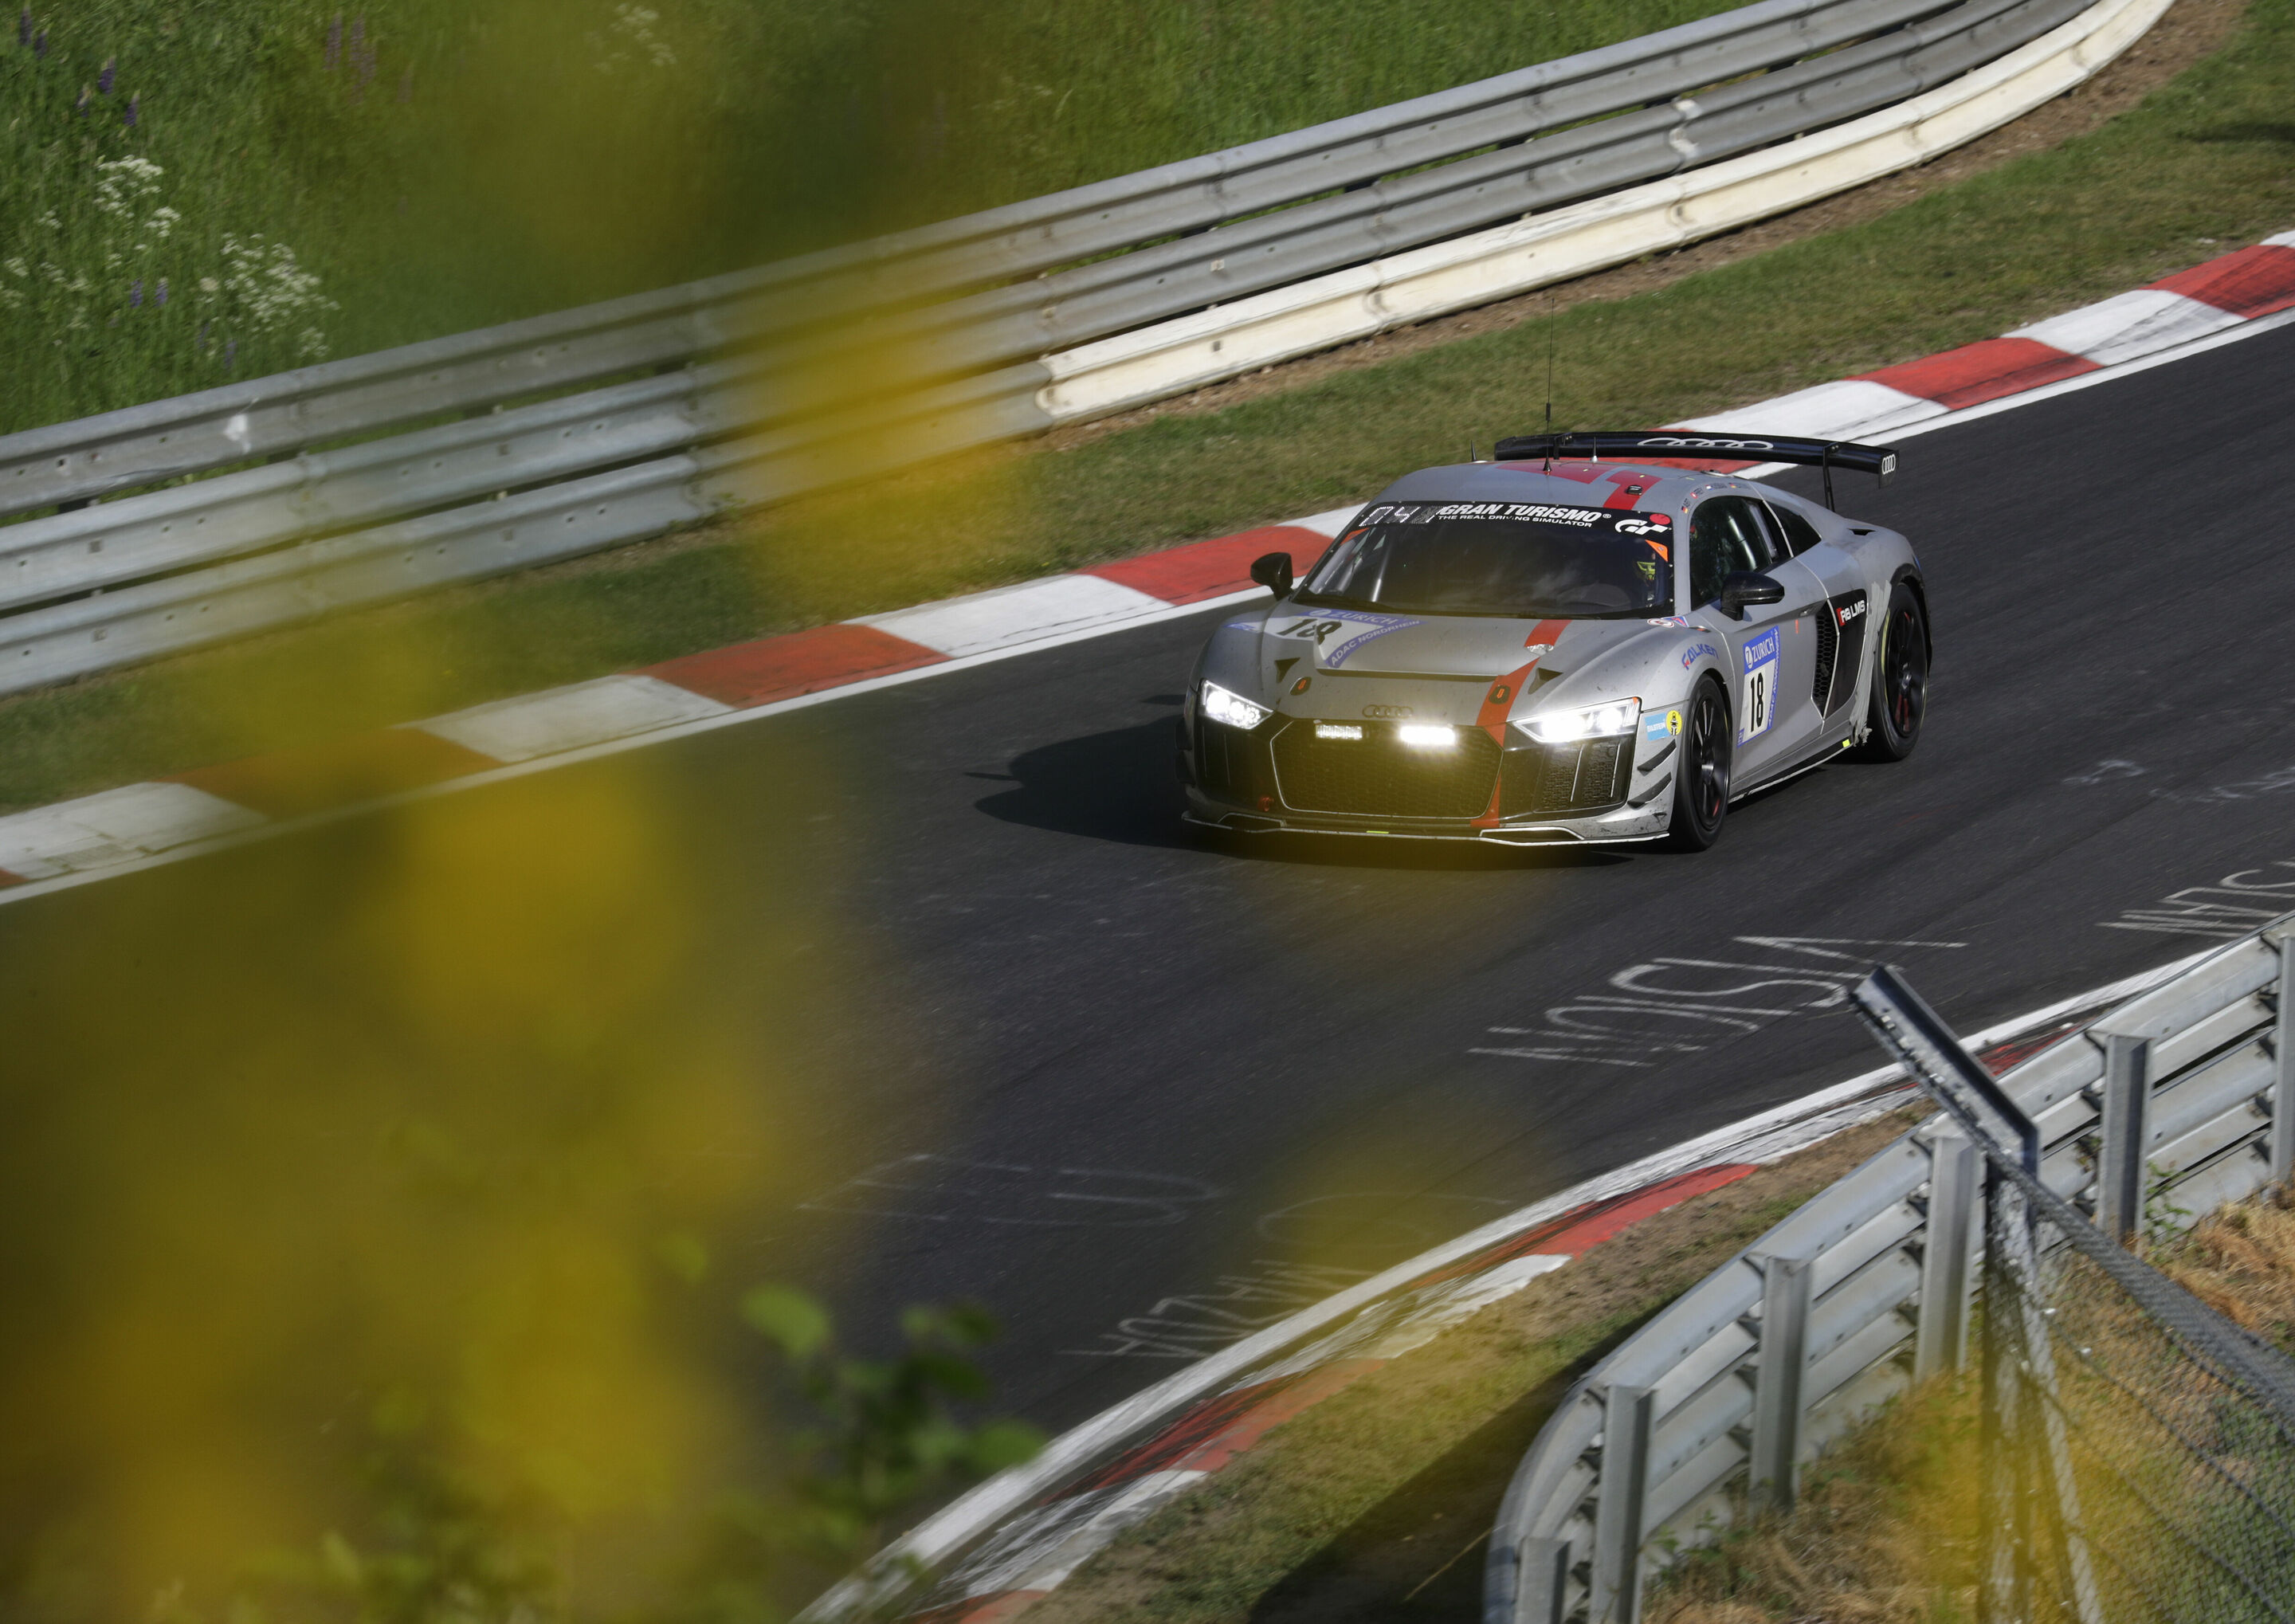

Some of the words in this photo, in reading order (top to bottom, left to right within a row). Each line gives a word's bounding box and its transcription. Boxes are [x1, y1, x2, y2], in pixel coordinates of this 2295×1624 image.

[1440, 504, 1504, 515] GRAN
[1532, 516, 1592, 528] SIMULATOR
[1329, 610, 1399, 625] ZURICH
[1850, 600, 1865, 618] LMS
[1331, 640, 1356, 666] ADAC
[1359, 620, 1420, 643] NORDRHEIN
[1752, 637, 1775, 662] ZURICH
[1681, 643, 1719, 670] FALKEN
[1751, 672, 1763, 732] 18
